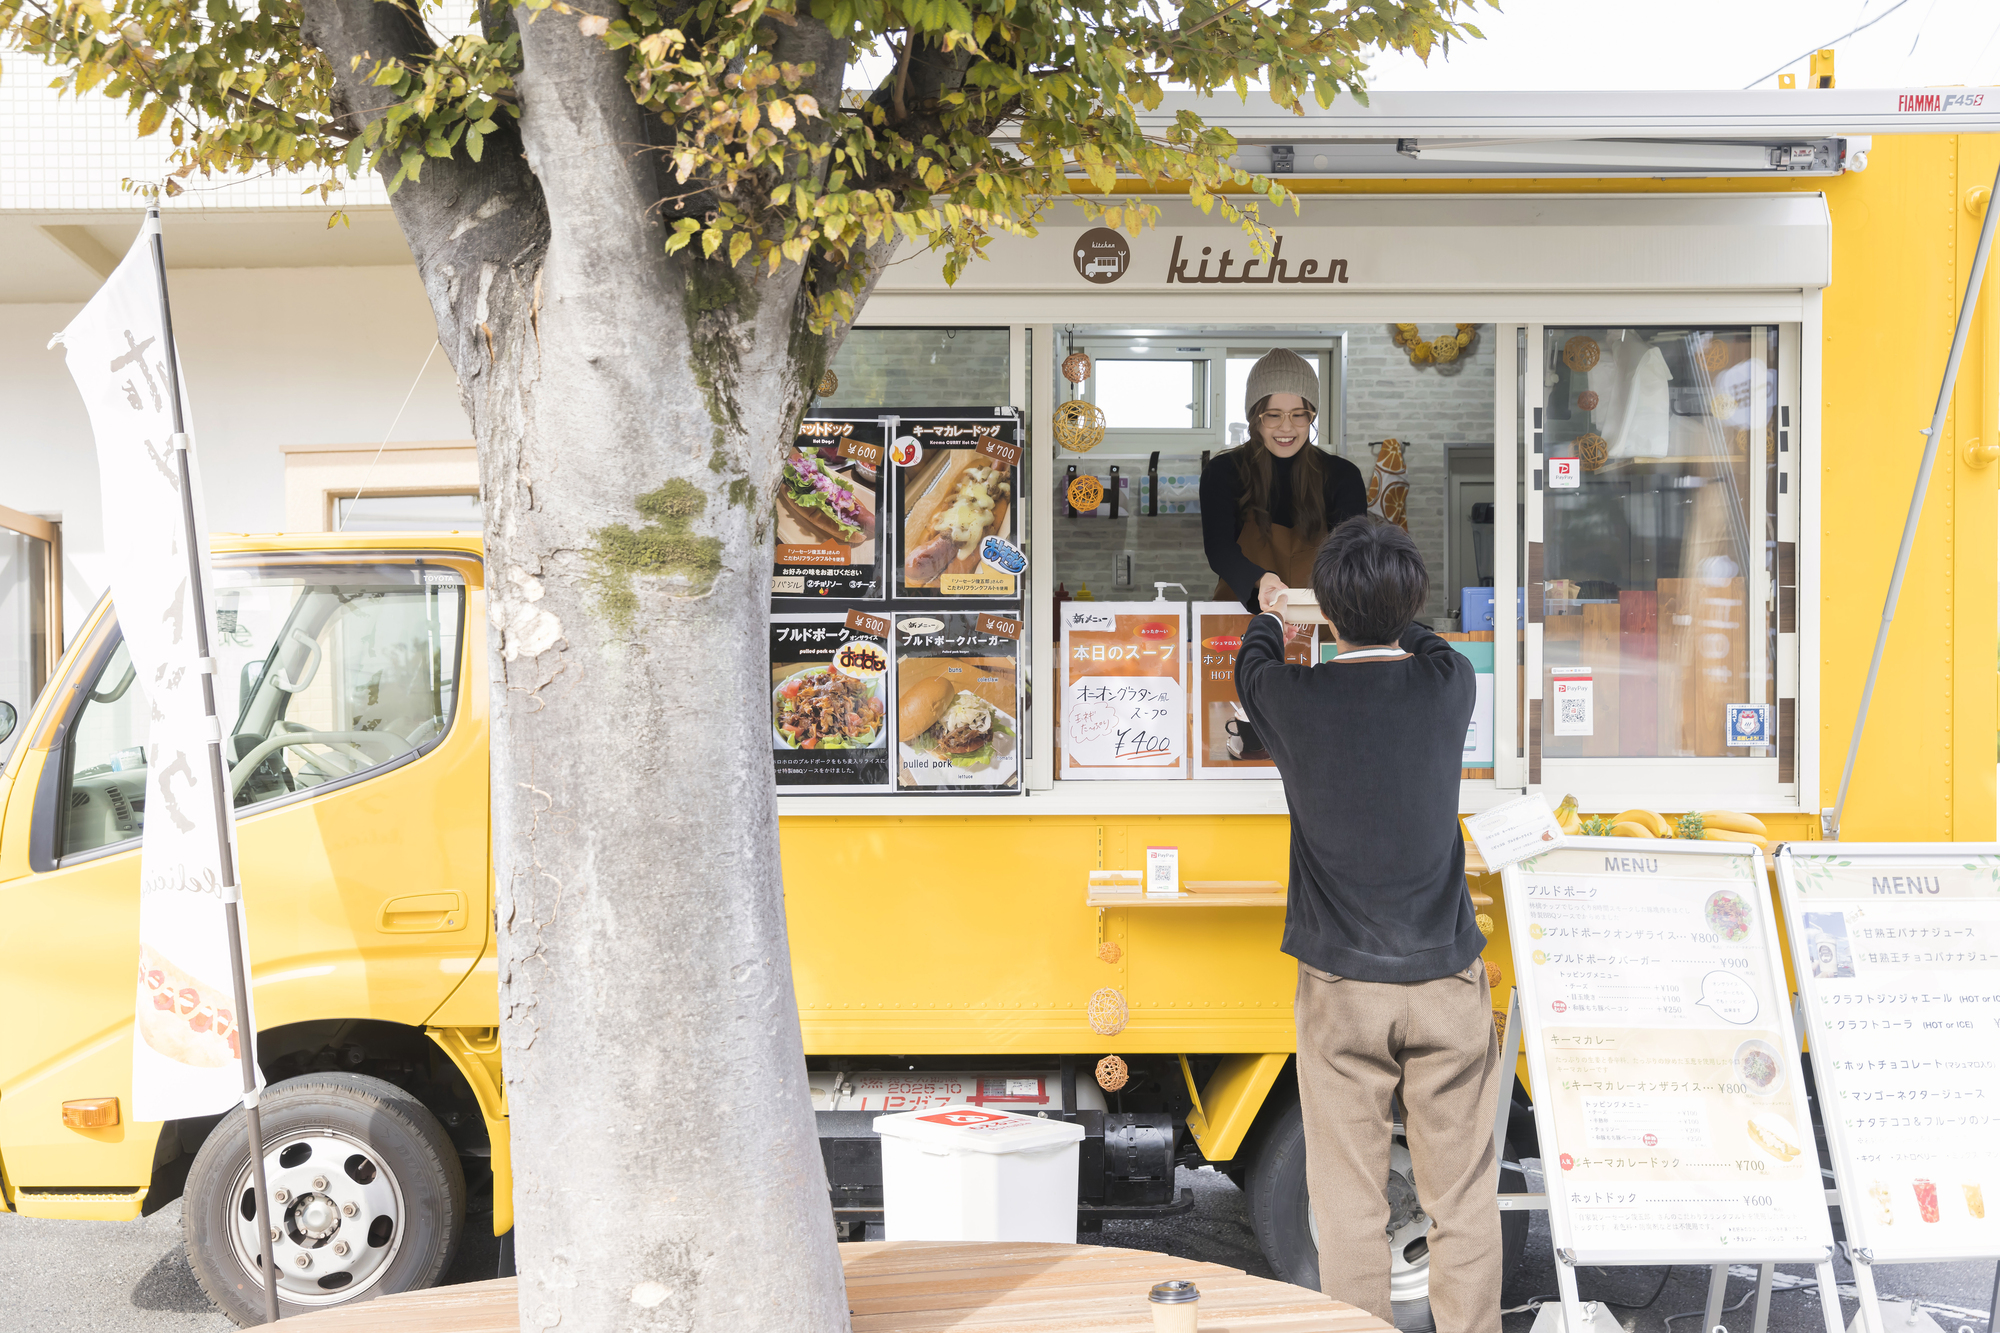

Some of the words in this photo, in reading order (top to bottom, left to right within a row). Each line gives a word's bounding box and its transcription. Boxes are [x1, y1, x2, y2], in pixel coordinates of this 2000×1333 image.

[1898, 95, 1941, 112] FIAMMA
[1166, 235, 1349, 283] kitchen
[847, 442, 877, 460] ¥600
[985, 441, 1015, 460] ¥700
[854, 614, 884, 632] ¥800
[985, 618, 1015, 634] ¥900
[1072, 612, 1108, 624] 新メニュー
[1073, 643, 1176, 661] 本日のスープ
[1210, 671, 1233, 680] HOT
[1114, 727, 1171, 755] ¥400
[903, 759, 929, 769] pulled
[932, 759, 953, 769] pork
[1605, 856, 1659, 873] MENU
[1527, 885, 1598, 898] プルドポーク
[1872, 876, 1941, 895] MENU
[1690, 932, 1720, 944] ¥800
[1553, 953, 1661, 966] プルドポークバーガー
[1719, 957, 1749, 969] ¥900
[1832, 993, 1953, 1005] クラフトジンジャエール
[1837, 1019, 1914, 1030] クラフトコーラ
[1956, 1020, 1974, 1030] ICE)
[1550, 1033, 1616, 1046] キーマカレー
[1844, 1058, 1943, 1071] ホットチョコレート
[887, 1083, 962, 1095] 2025-10
[1571, 1079, 1703, 1093] キーマカレーオンザライス
[1717, 1082, 1748, 1095] ¥800
[1851, 1088, 1986, 1101] マンゴーネクタージュース
[1735, 1160, 1766, 1172] ¥700
[1571, 1191, 1637, 1204] ホットドック
[1742, 1195, 1773, 1207] ¥600
